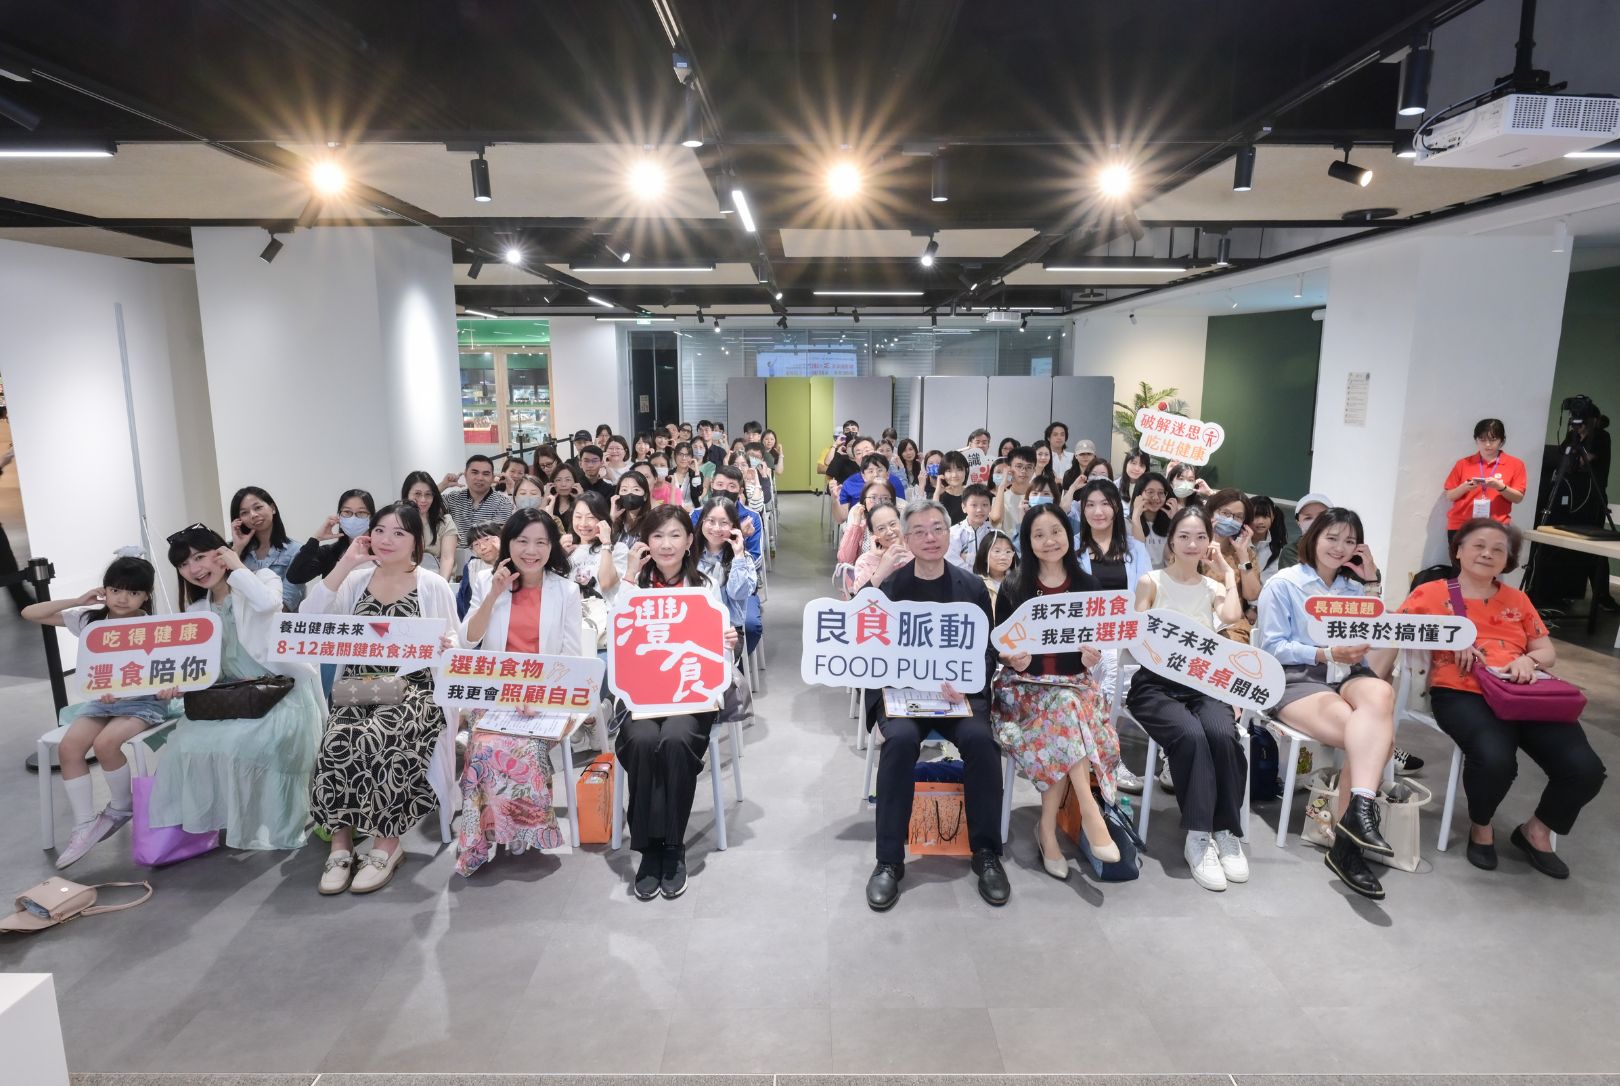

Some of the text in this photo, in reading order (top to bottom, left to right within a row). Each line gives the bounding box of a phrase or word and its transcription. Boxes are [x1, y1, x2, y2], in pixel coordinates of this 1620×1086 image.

[1140, 413, 1201, 440] 破解迷思
[1145, 435, 1206, 461] 吃出健康
[1031, 595, 1128, 620] 我不是挑食
[1314, 600, 1375, 615] 長高這題
[102, 623, 198, 648] 吃得健康
[279, 620, 365, 636] 養出健康未來
[815, 599, 976, 650] 良食脈動
[1041, 620, 1138, 645] 我是在選擇
[1327, 620, 1462, 643] 我終於搞懂了
[276, 640, 434, 659] 8-12歲關鍵飲食決策
[86, 656, 207, 690] 灃食陪你
[448, 654, 545, 679] 選對食物
[814, 654, 974, 683] FOOD PULSE
[1166, 652, 1270, 705] 從餐桌開始
[447, 683, 591, 707] 我更會照顧自己
